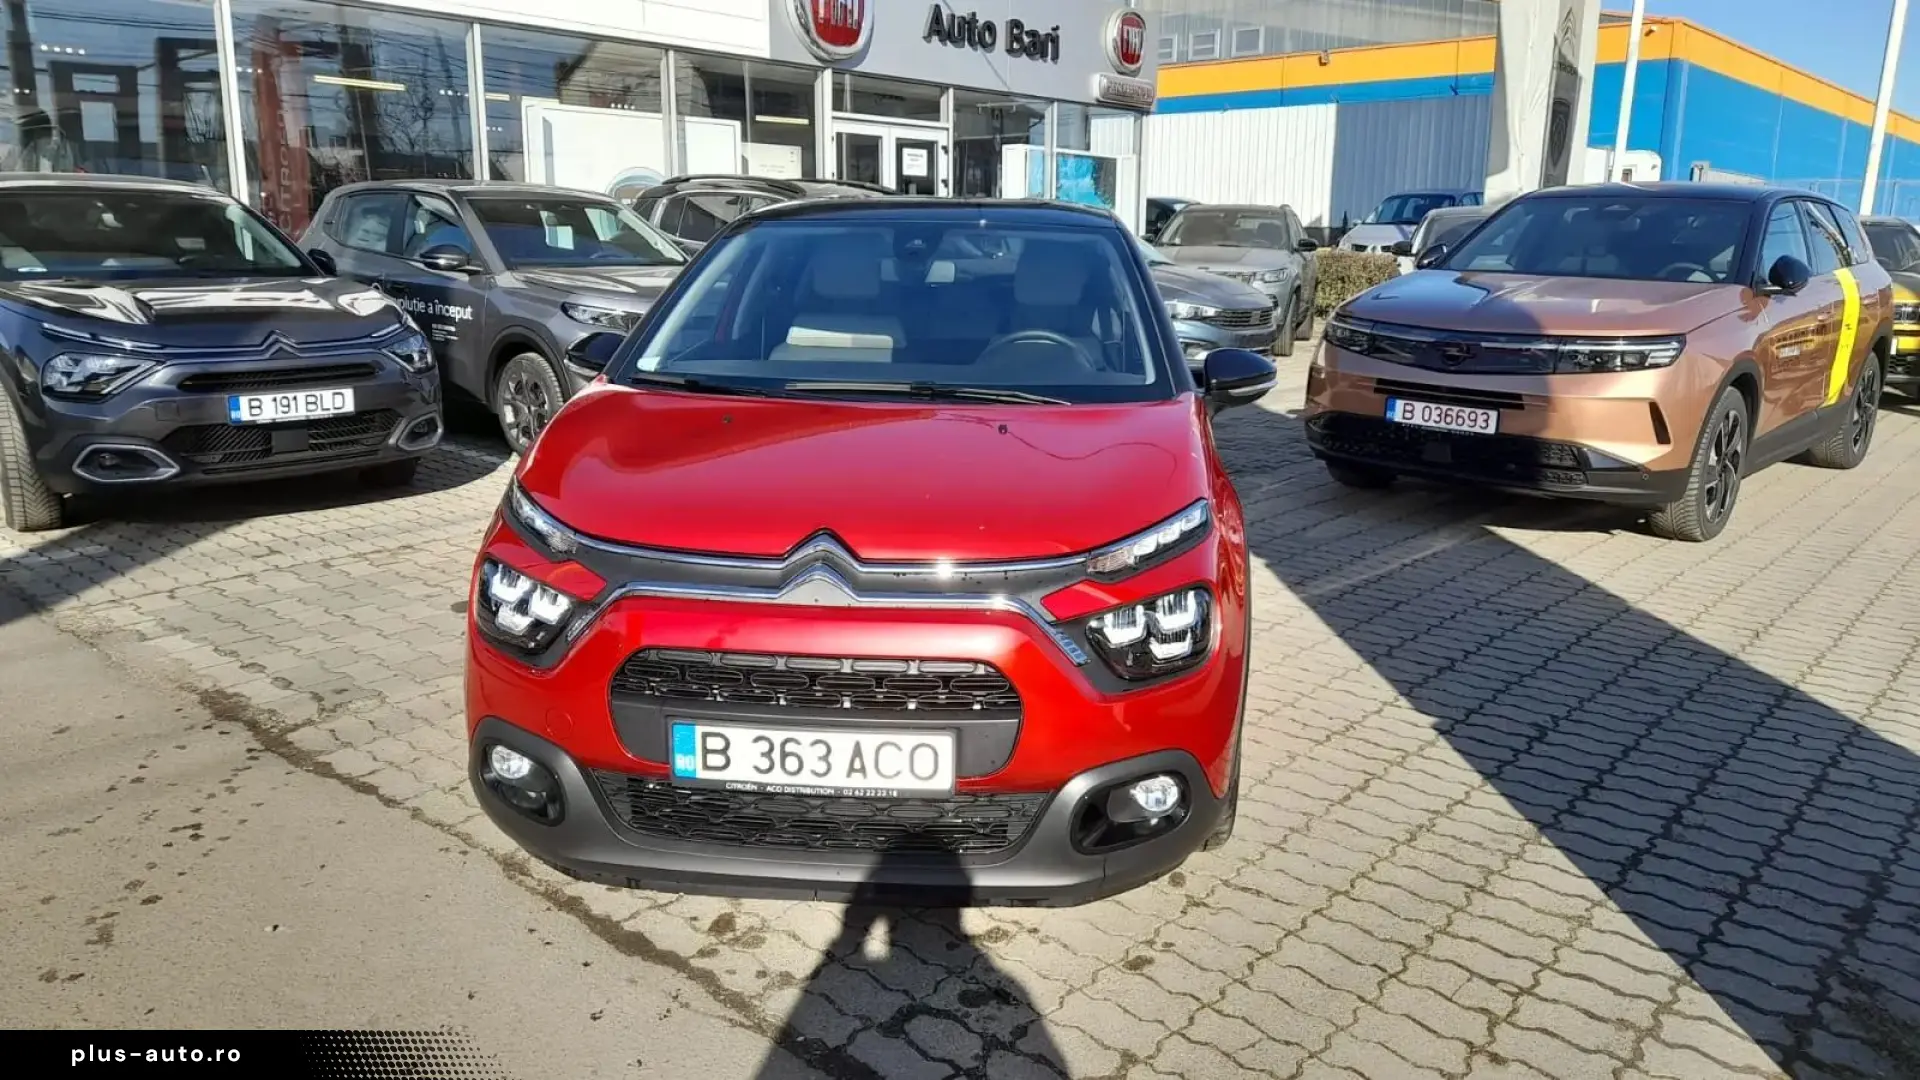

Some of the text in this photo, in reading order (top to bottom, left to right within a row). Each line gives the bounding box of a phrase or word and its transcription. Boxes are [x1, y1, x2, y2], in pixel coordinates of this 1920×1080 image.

[925, 3, 1061, 63] Auto Bari
[427, 301, 433, 314] a
[434, 299, 473, 322] început
[248, 391, 345, 417] B 191 BLD
[1402, 402, 1416, 421] B
[1422, 405, 1490, 430] 036693
[701, 731, 940, 782] B 363 ACO
[766, 784, 783, 794] ACO
[784, 786, 835, 796] DISTRIBUTION
